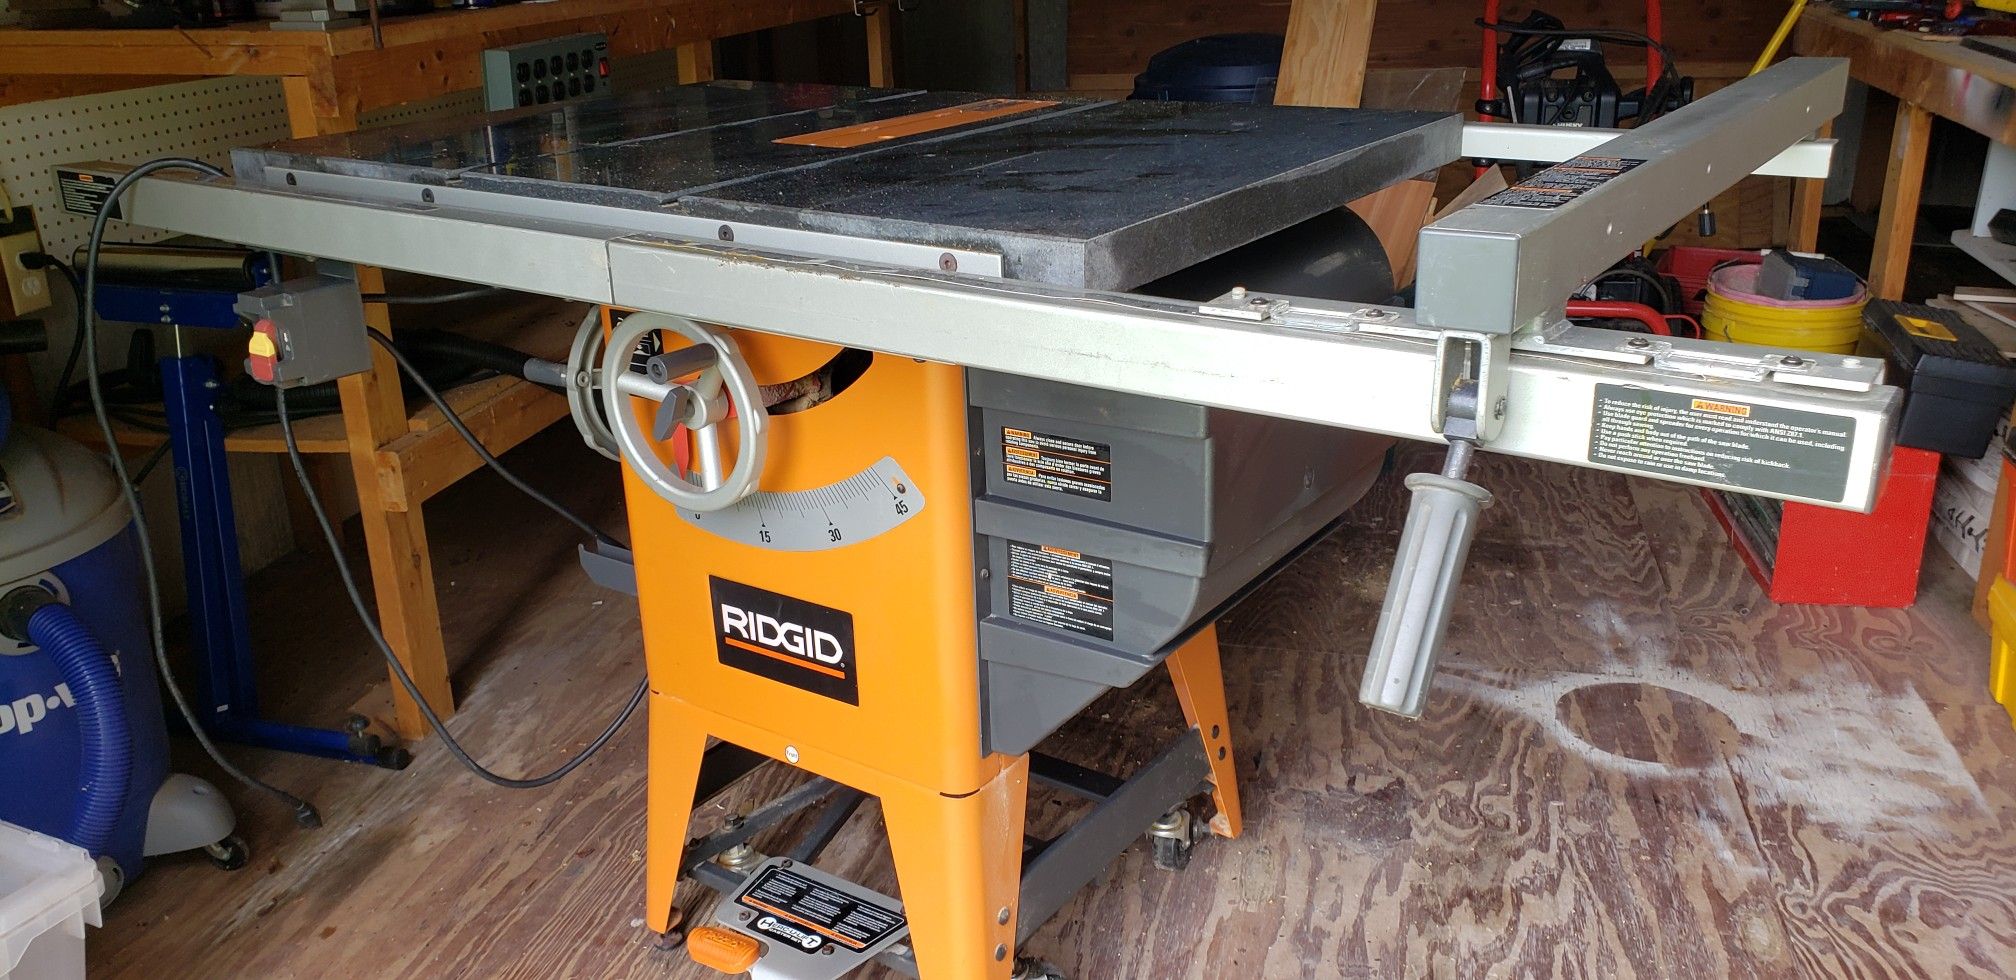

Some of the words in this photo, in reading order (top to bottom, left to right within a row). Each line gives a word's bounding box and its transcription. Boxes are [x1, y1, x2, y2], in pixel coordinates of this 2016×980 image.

[1706, 403, 1747, 415] WARNING
[895, 501, 909, 515] 45
[759, 530, 771, 543] 15
[828, 528, 842, 542] 30
[721, 603, 843, 664] RIDGID
